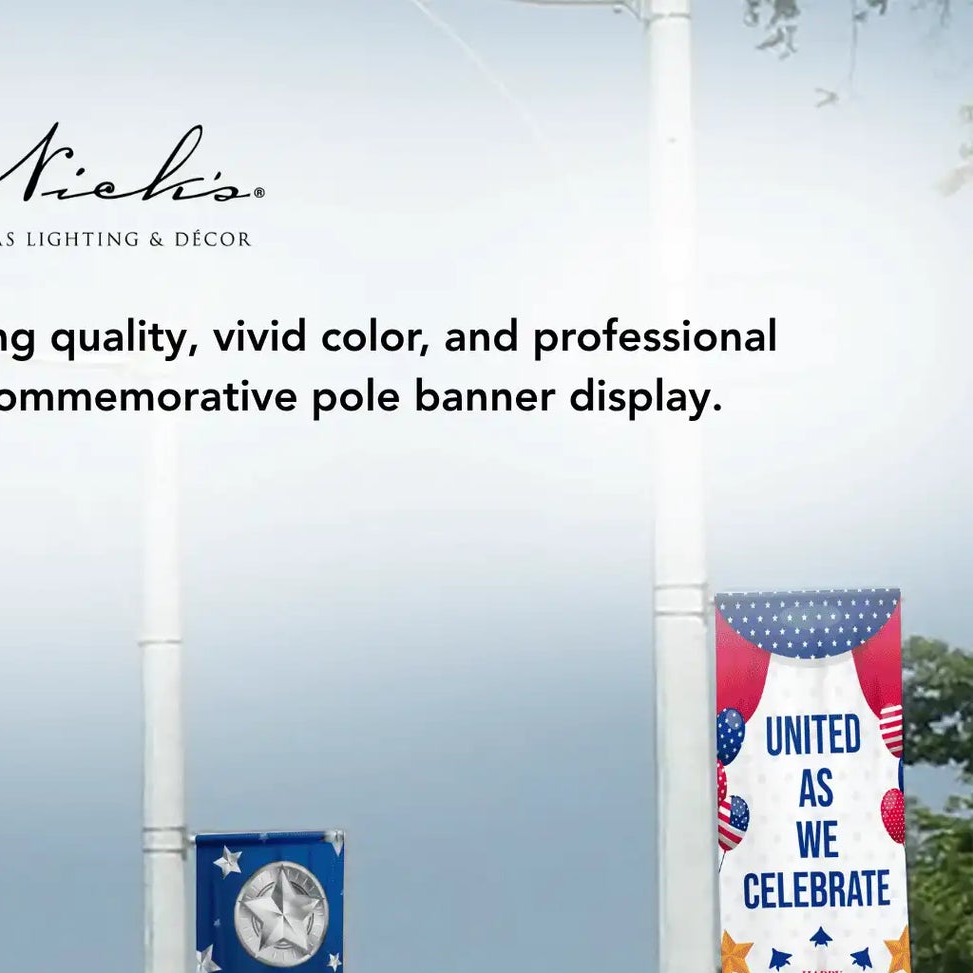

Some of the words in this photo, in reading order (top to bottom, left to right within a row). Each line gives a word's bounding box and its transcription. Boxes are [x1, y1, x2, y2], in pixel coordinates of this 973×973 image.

[765, 713, 861, 757] UNITED
[798, 767, 834, 808] AS
[796, 819, 839, 860] WE
[743, 869, 891, 910] CELEBRATE
